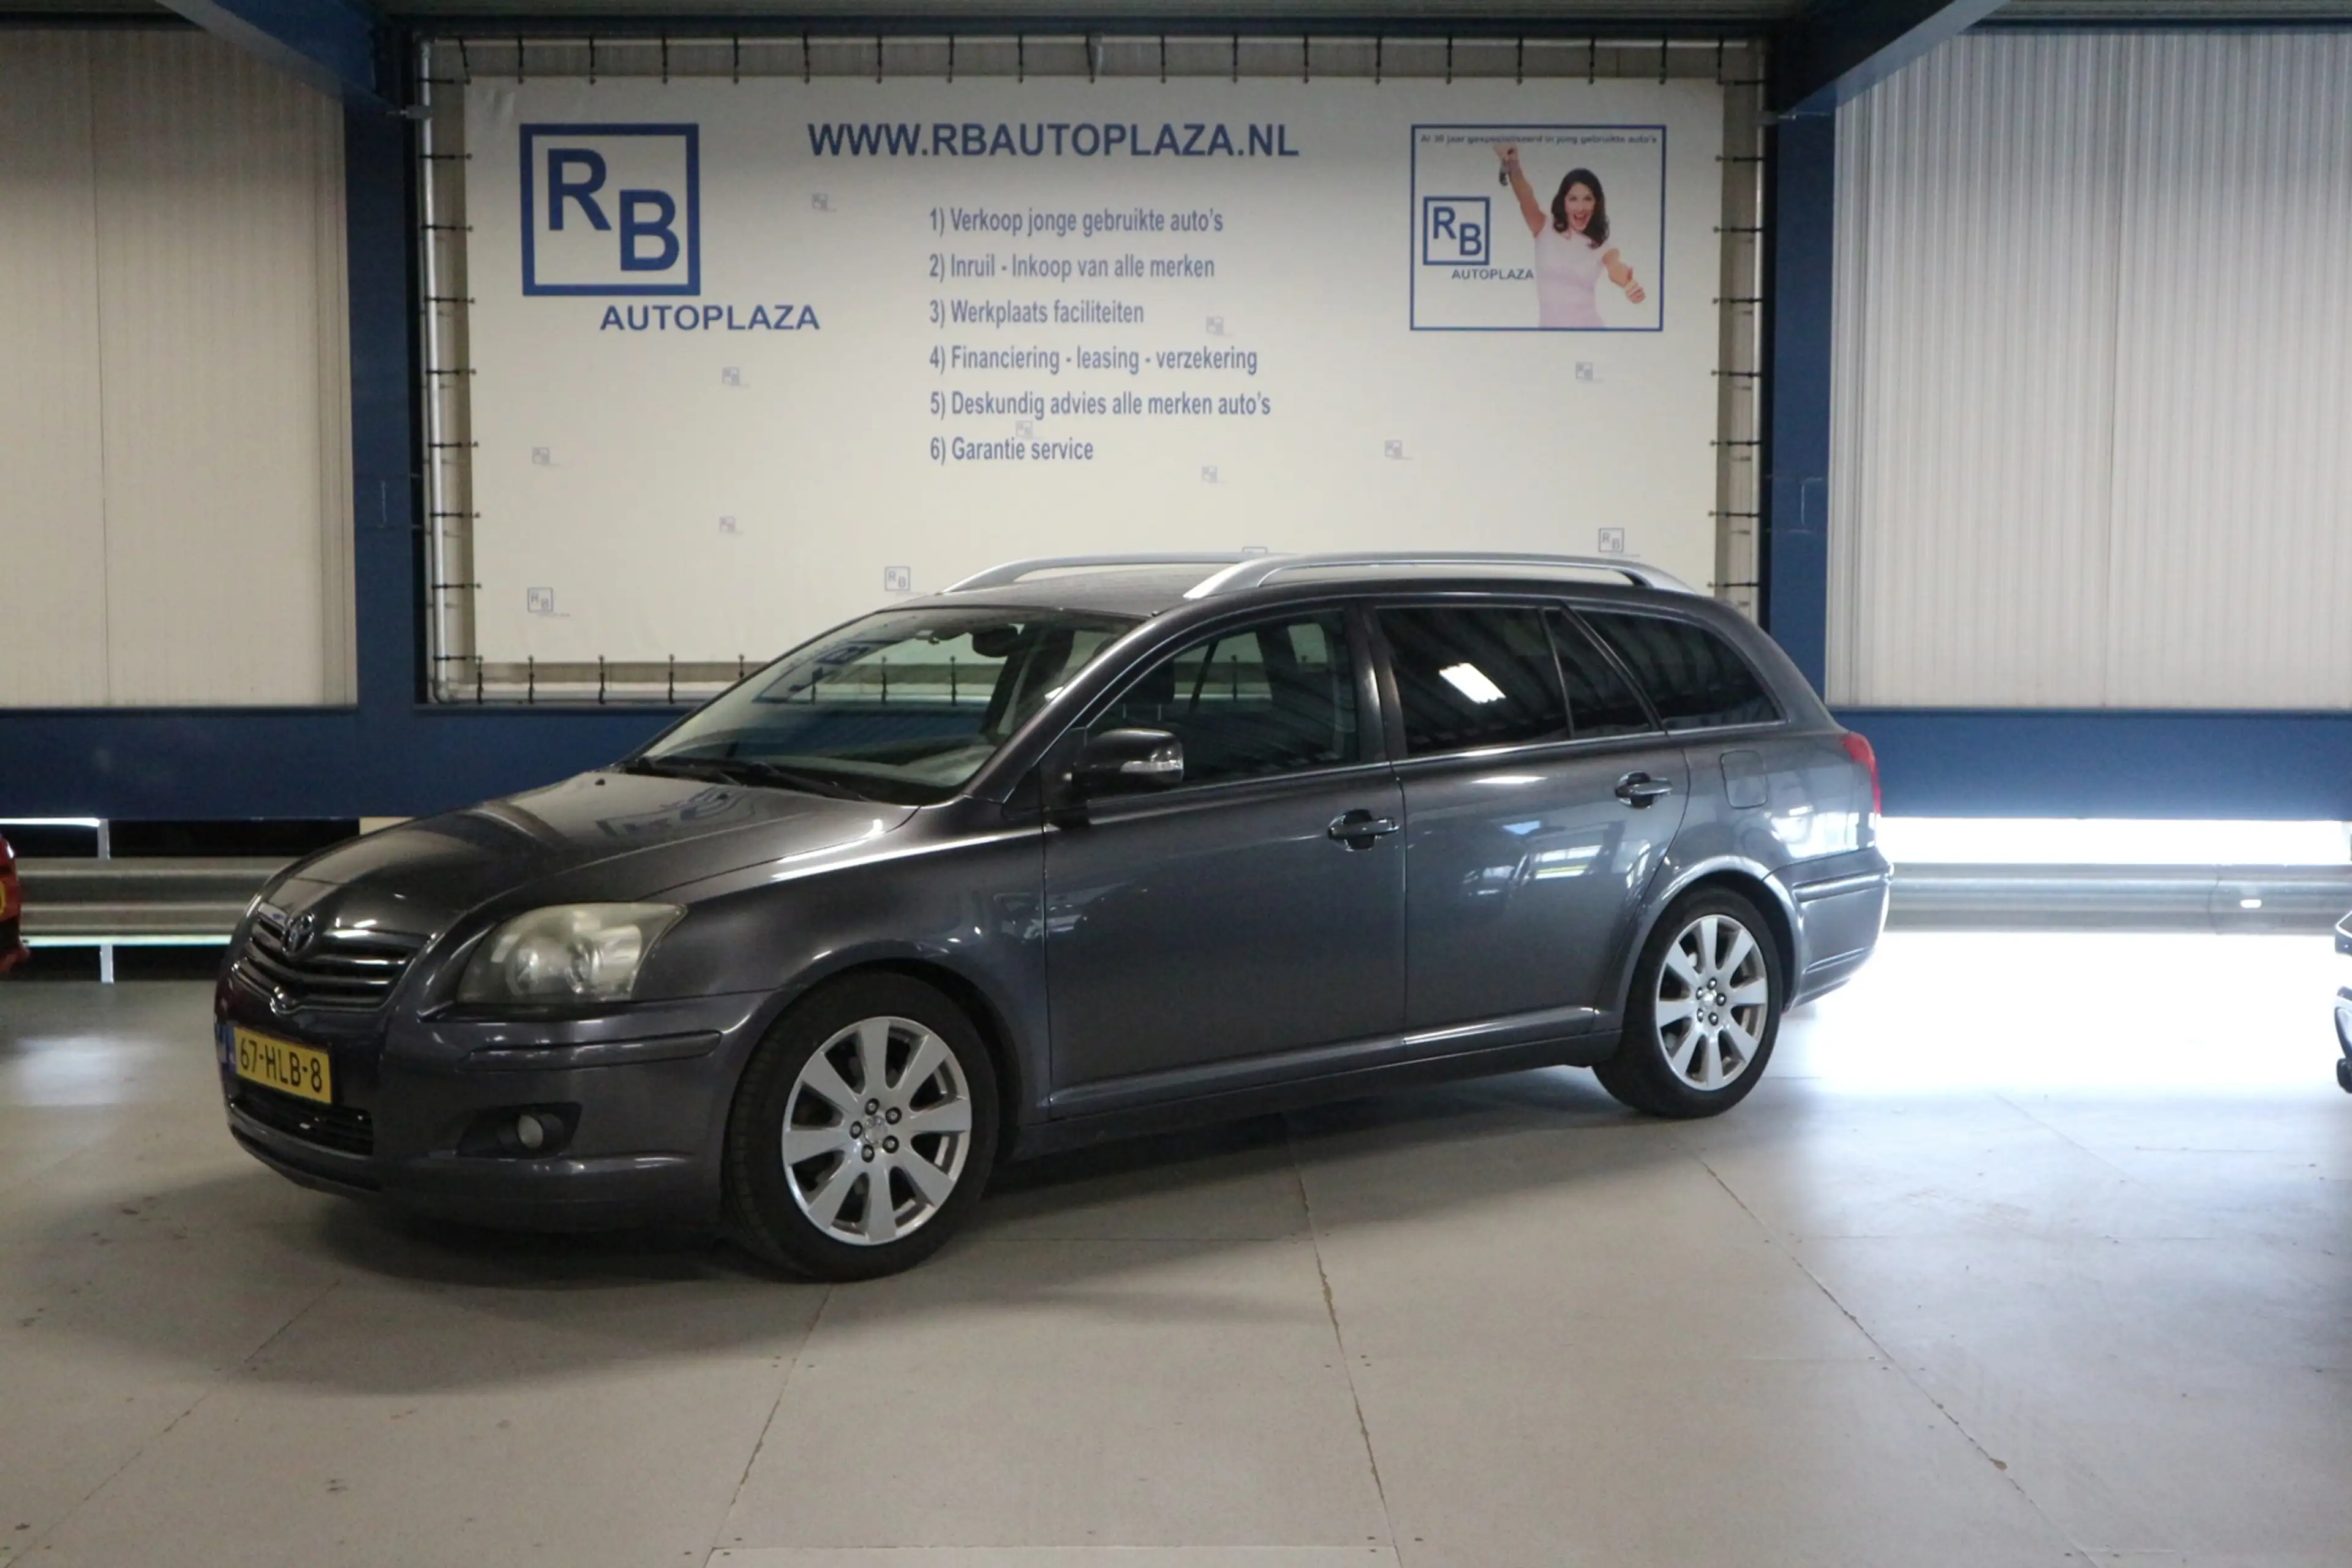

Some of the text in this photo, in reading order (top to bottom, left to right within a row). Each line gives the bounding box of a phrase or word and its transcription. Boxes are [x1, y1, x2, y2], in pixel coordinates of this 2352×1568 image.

[807, 123, 1299, 157] WWW.RBAUTOPLAZA.NL
[930, 208, 1223, 238] 1) Verkoop jonge gebruikte auto's
[1433, 206, 1483, 256] RB
[930, 254, 945, 282] 2)
[951, 254, 995, 277] Inruil
[1012, 254, 1072, 283] Inkoop
[1078, 260, 1109, 277] van
[1115, 254, 1144, 277] alle
[1150, 254, 1215, 277] merken
[1451, 268, 1534, 281] AUTOPLAZA
[600, 304, 821, 331] AUTOPLAZA
[930, 300, 1144, 329] 3) Werkplaats faciliteiten
[930, 345, 946, 375] 4)
[951, 345, 1060, 375] Financiering
[1077, 345, 1139, 375] leasing
[1156, 345, 1257, 376] verzekering
[930, 391, 1271, 421] 5) Deskundig advies alle merken auto's
[930, 437, 1093, 466] 6) Garantie service
[239, 1036, 322, 1094] 67-HLB-8
